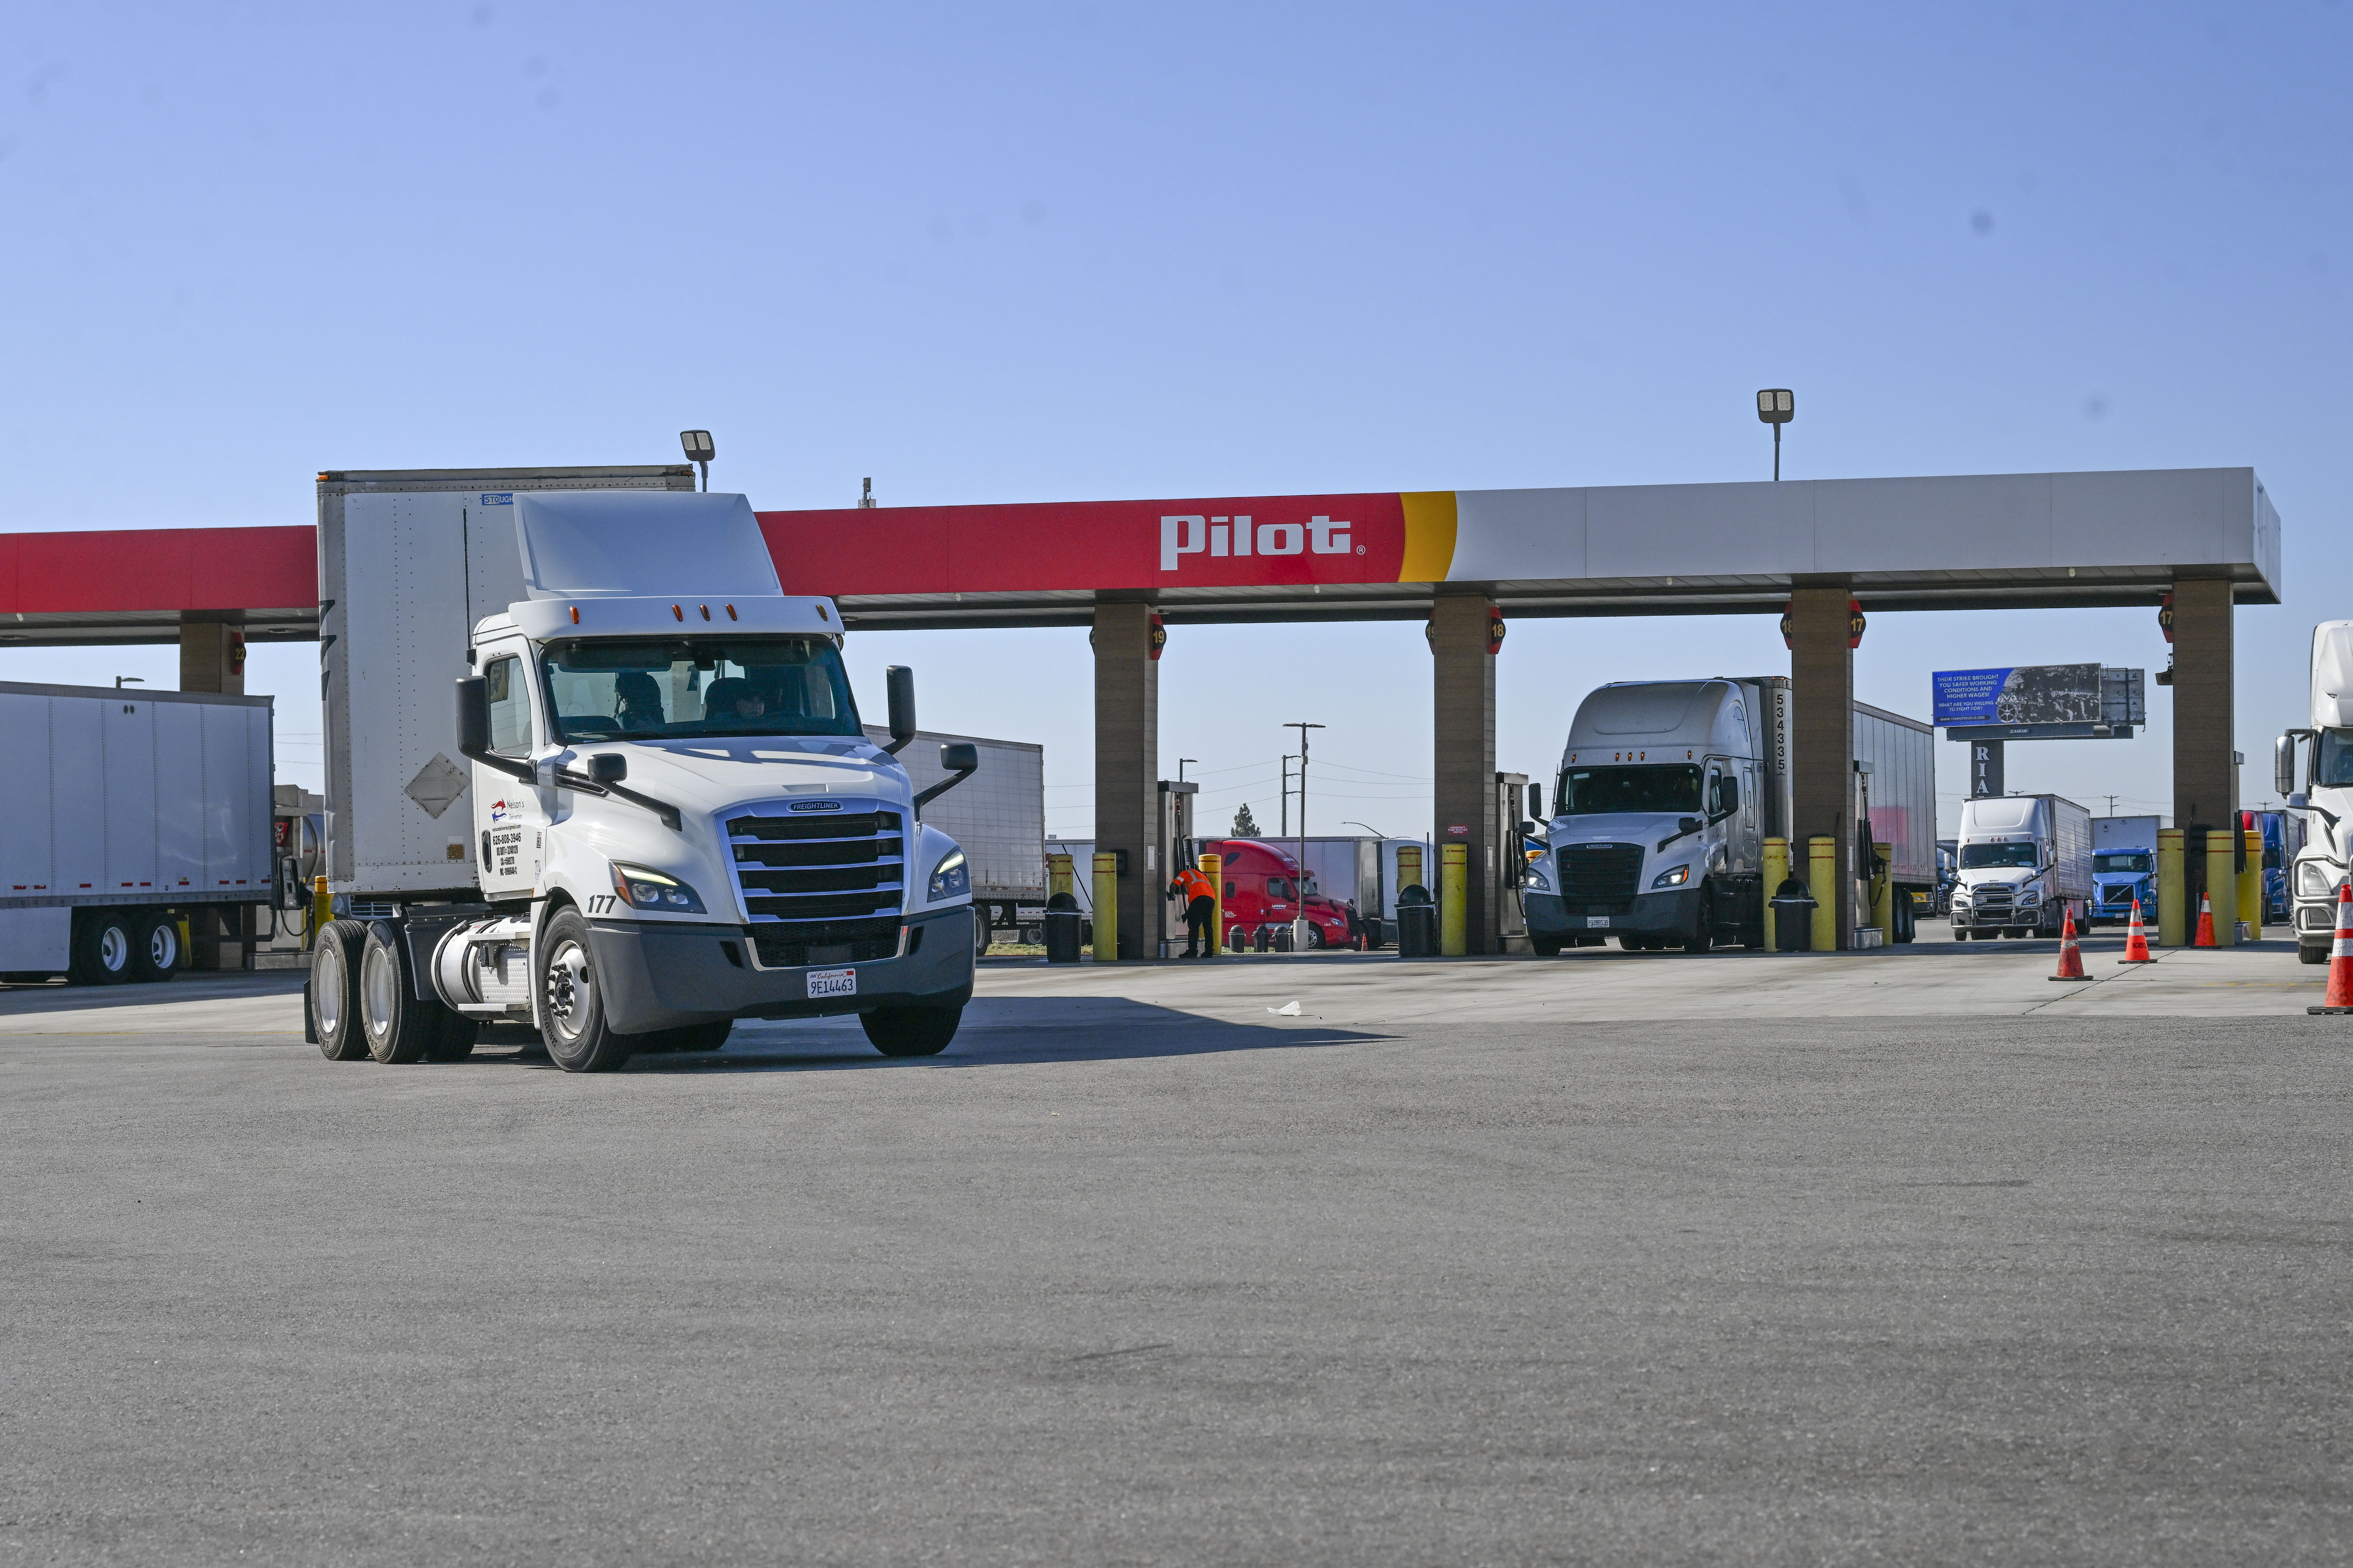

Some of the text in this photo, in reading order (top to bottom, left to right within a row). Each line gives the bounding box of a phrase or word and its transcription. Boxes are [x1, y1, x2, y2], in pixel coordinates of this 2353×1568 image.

[2160, 610, 2173, 625] 17
[1492, 624, 1504, 637] 18
[1851, 618, 1864, 632] 17
[1153, 630, 1165, 643] 19
[235, 647, 245, 660] 22
[1777, 694, 1785, 770] 534335
[1976, 746, 1990, 798] RIA
[507, 799, 525, 809] Nelson's
[492, 832, 521, 846] 626-808-3946
[588, 895, 616, 914] 177
[817, 972, 847, 980] California
[811, 978, 854, 994] 9E14463
